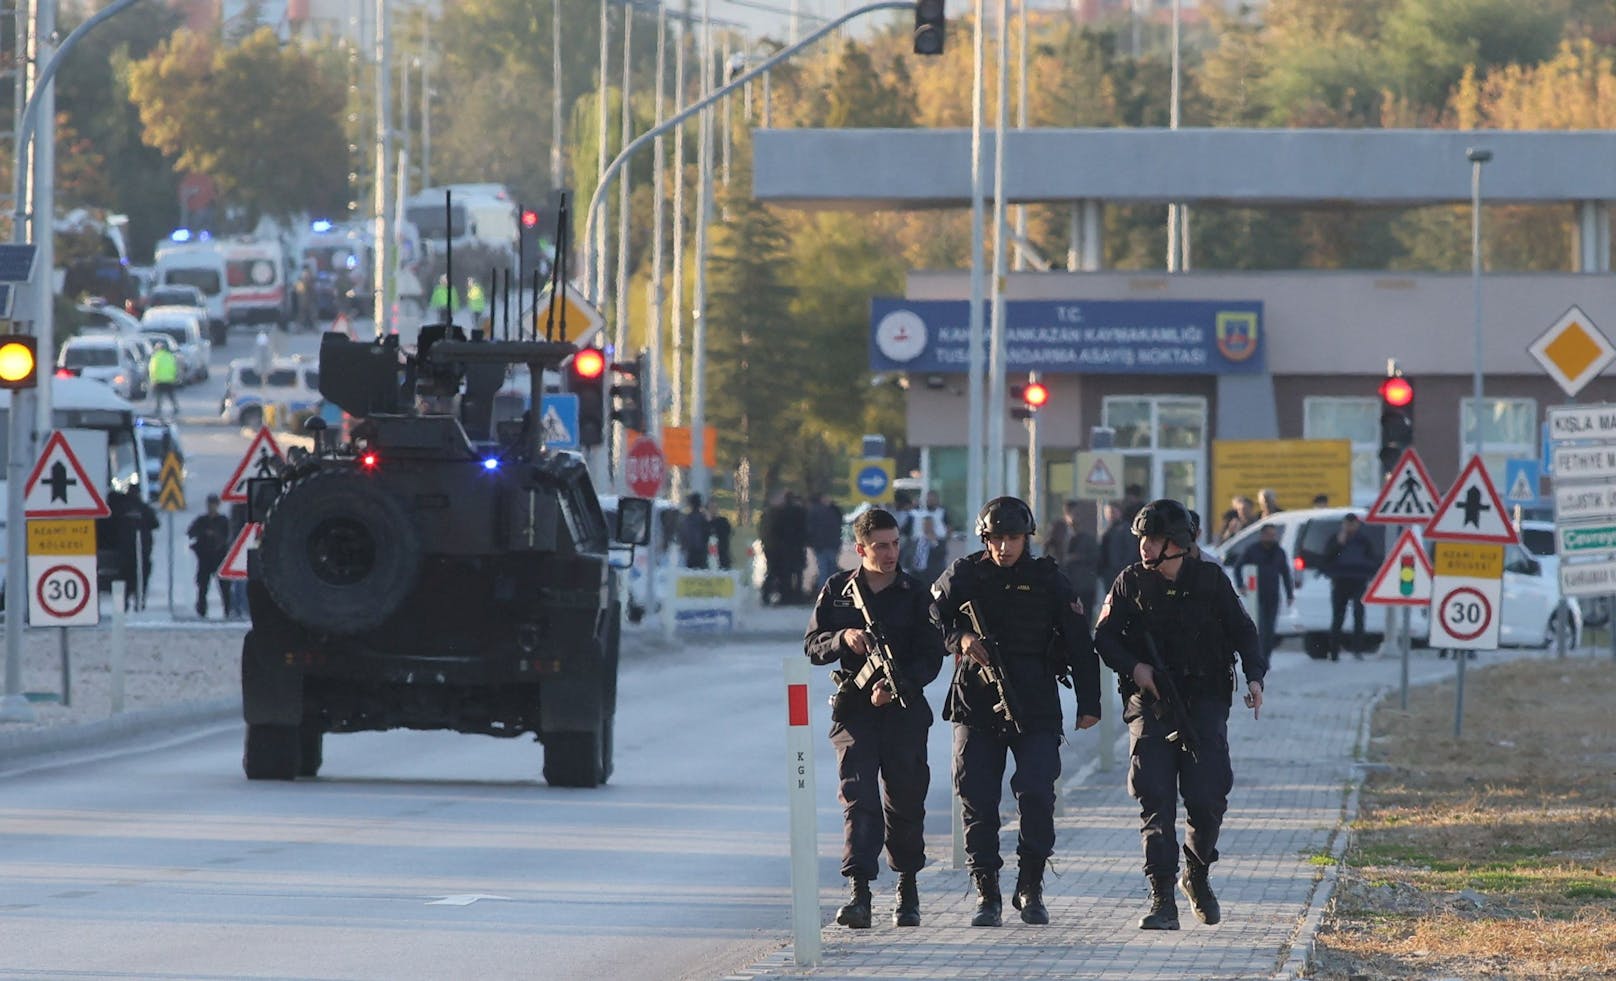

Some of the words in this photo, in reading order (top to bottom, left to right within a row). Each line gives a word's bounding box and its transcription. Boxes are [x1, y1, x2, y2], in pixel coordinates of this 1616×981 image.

[938, 327, 1079, 342] KAHAANKAZAN
[48, 579, 77, 600] 30
[1451, 602, 1480, 624] 30
